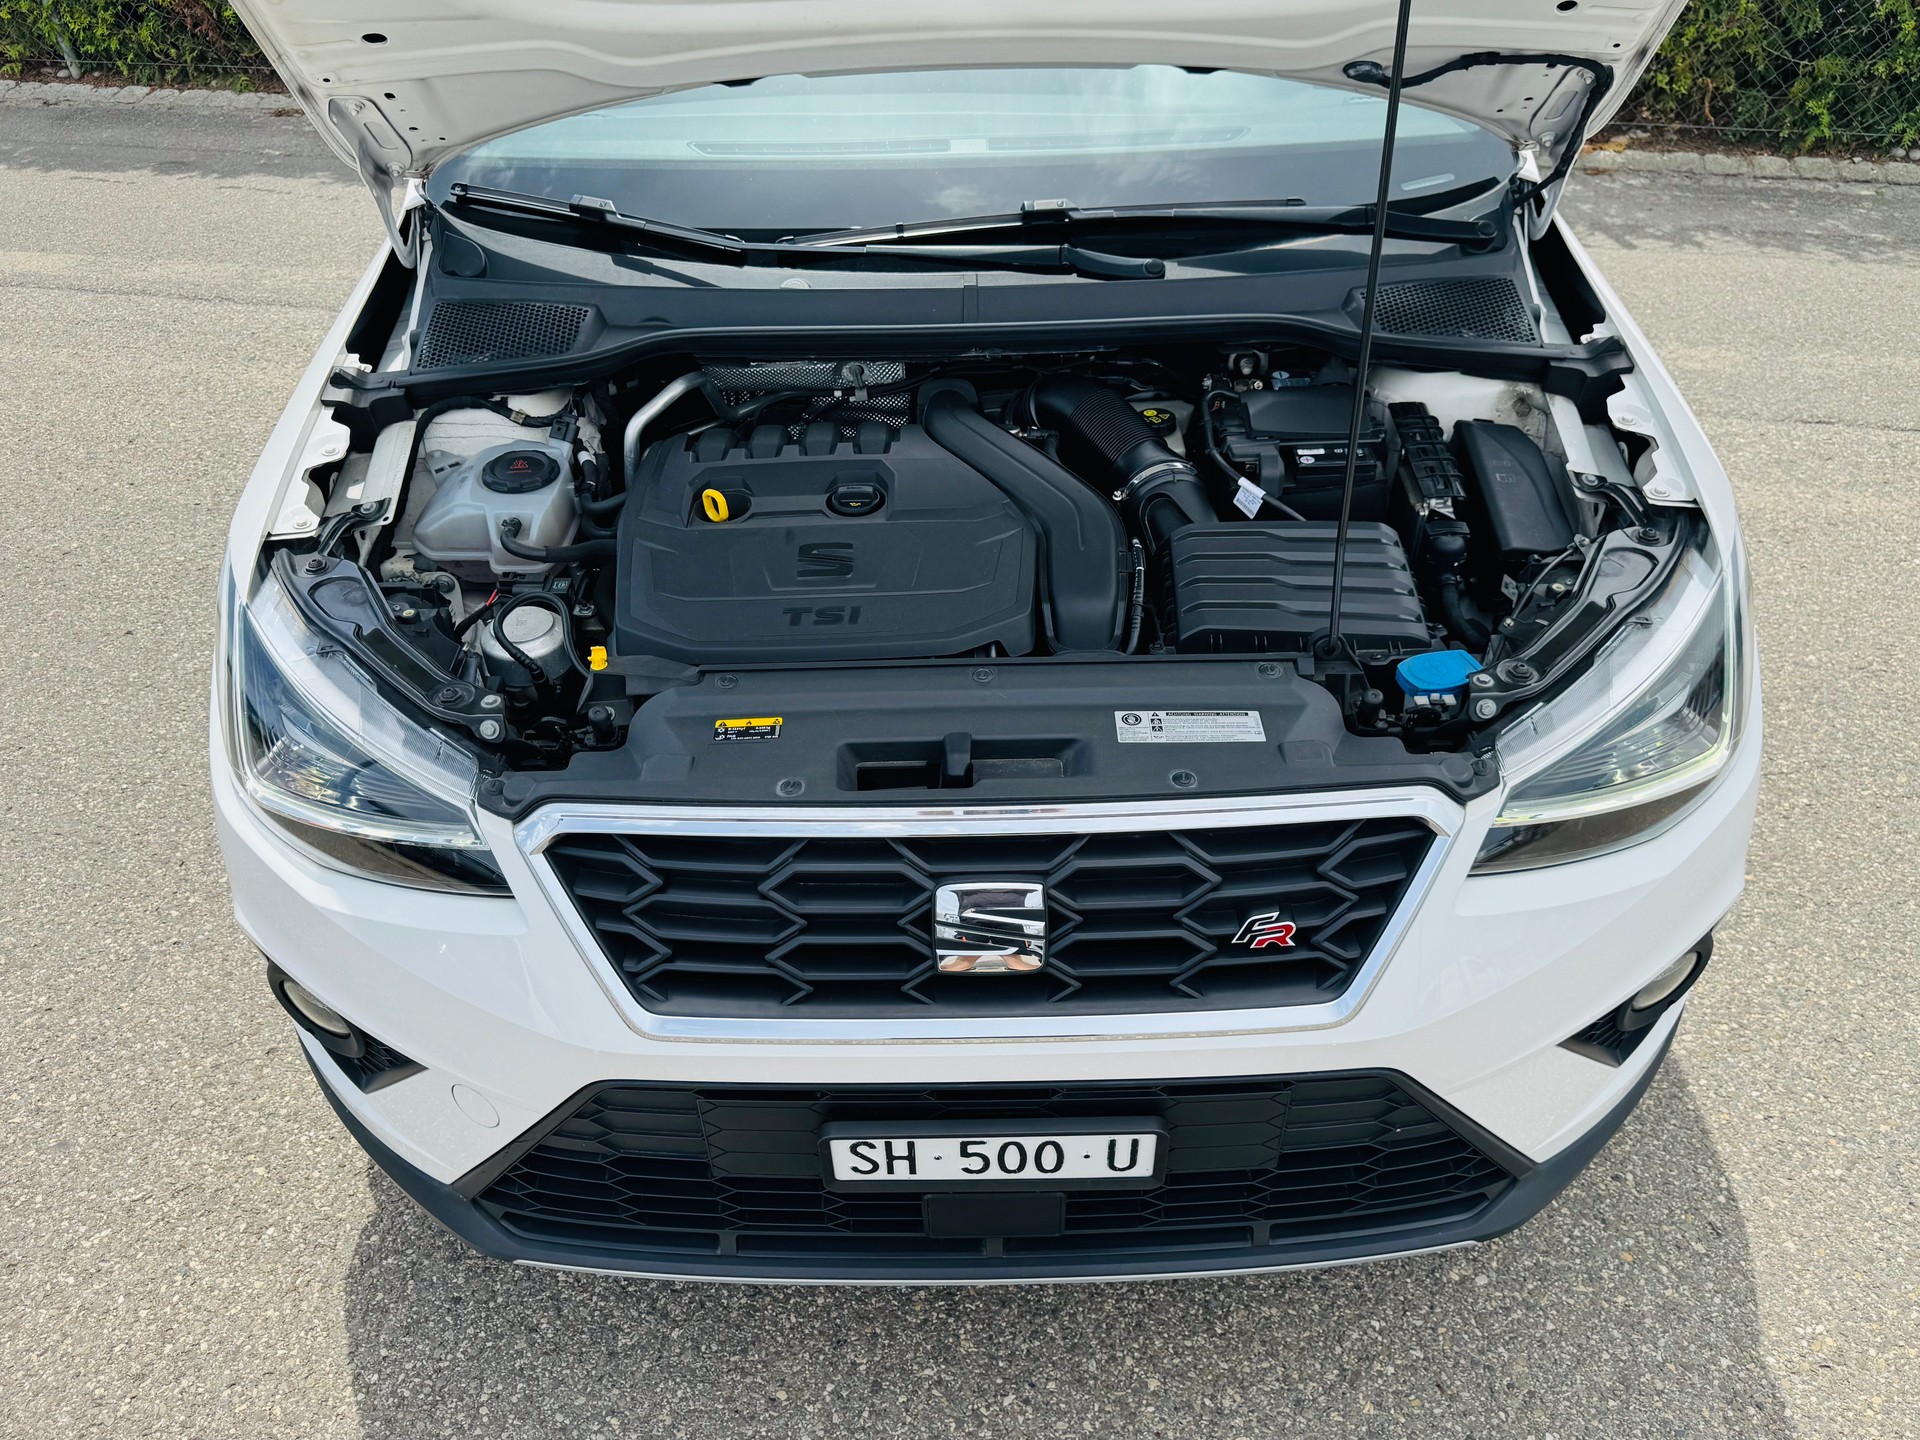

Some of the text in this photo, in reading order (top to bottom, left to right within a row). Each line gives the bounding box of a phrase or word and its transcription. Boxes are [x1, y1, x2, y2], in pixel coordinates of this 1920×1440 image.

[782, 605, 862, 627] TSI
[1231, 911, 1297, 949] FR
[849, 1138, 1140, 1175] SH 500 U
